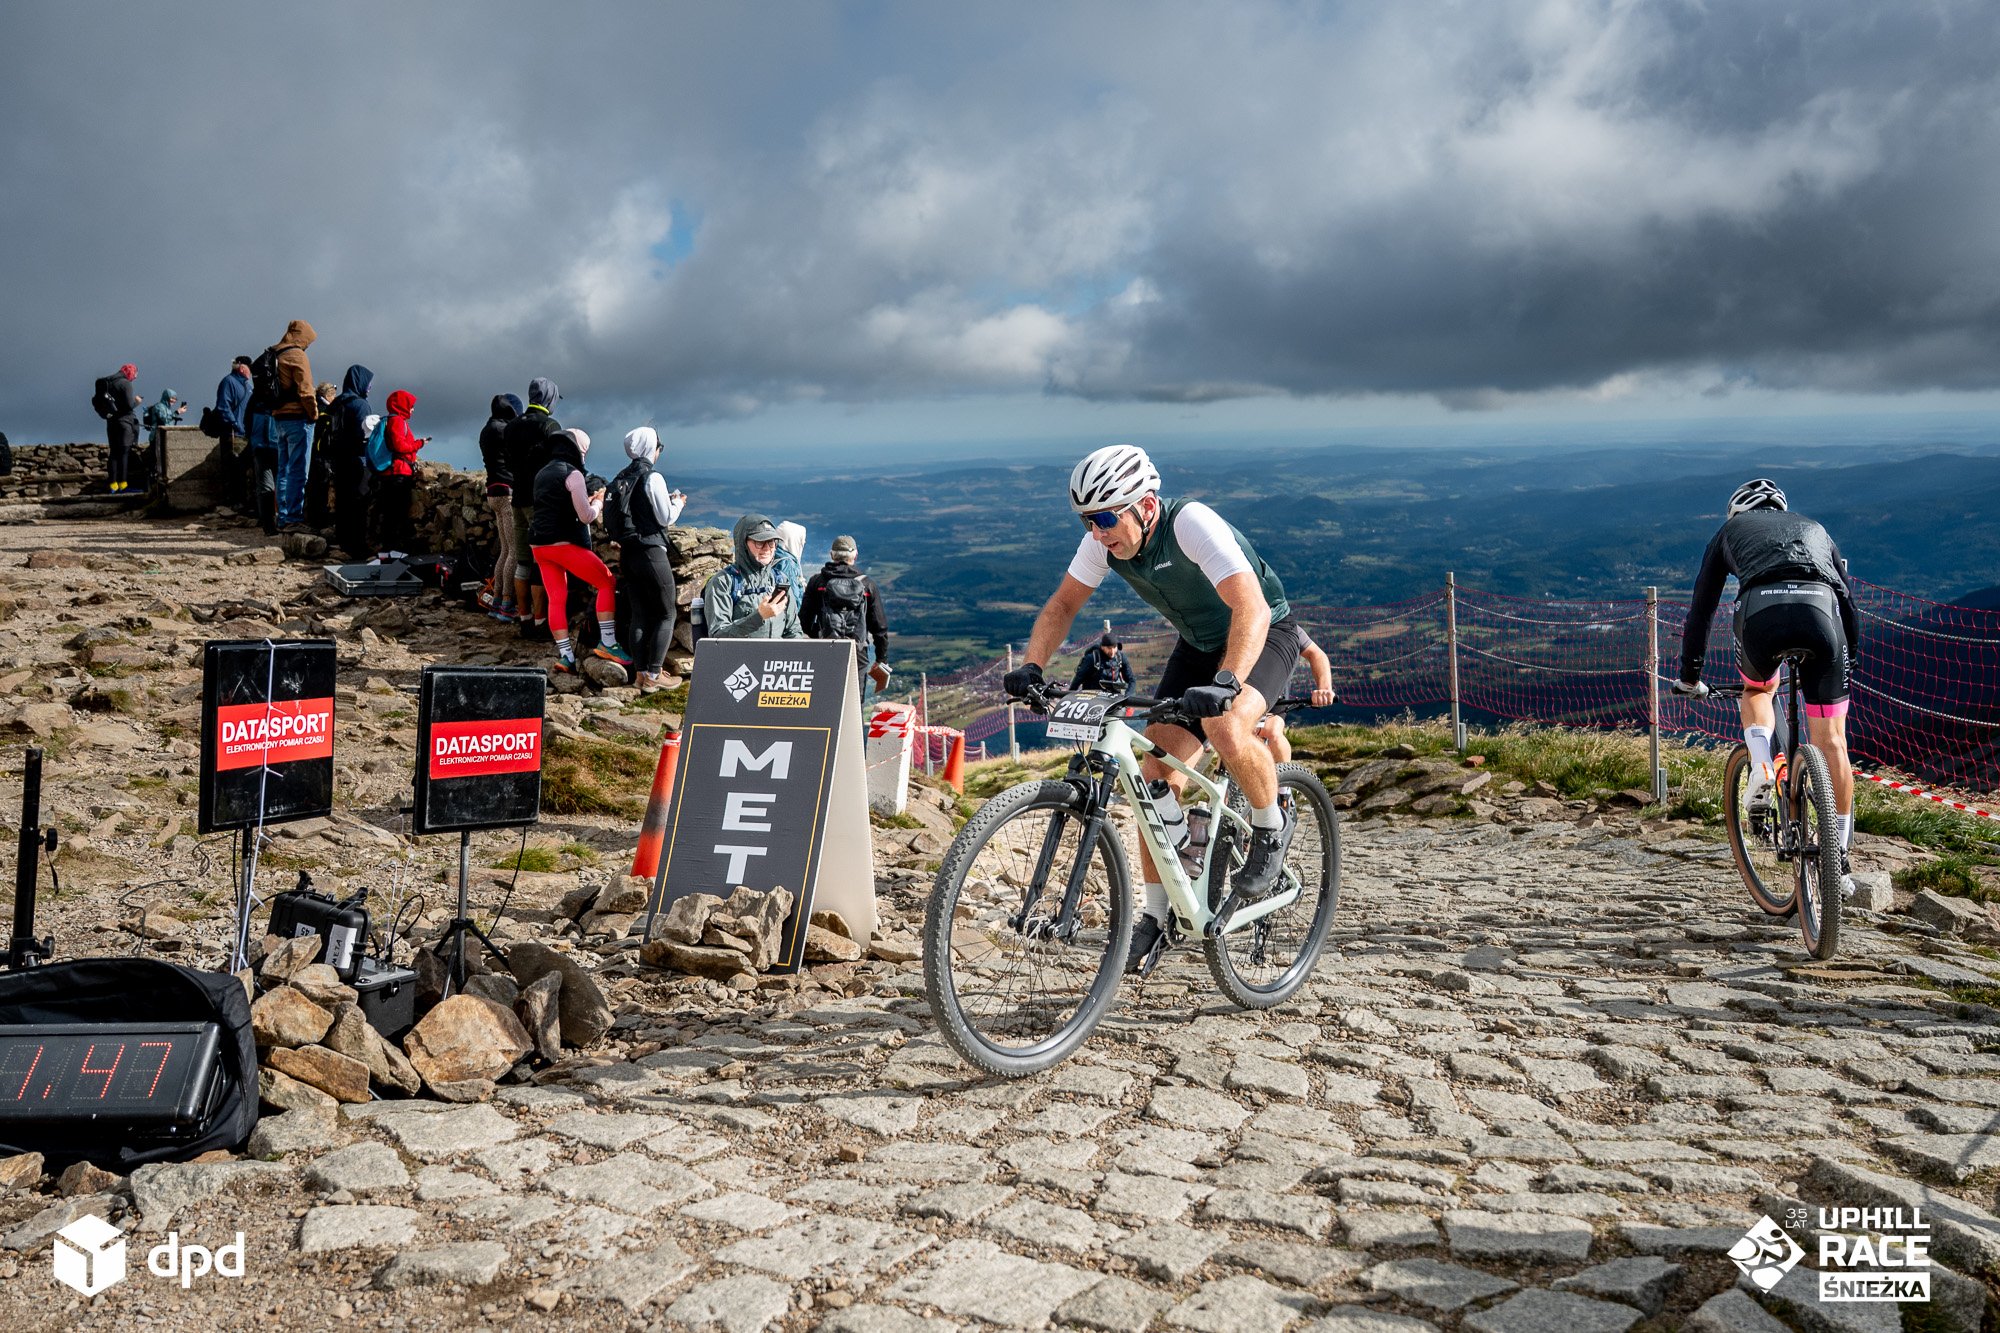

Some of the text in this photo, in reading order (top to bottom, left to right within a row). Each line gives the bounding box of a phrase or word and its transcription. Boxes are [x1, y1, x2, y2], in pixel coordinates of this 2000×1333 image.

[763, 660, 815, 673] UPHILL
[760, 674, 815, 691] RACE
[760, 693, 807, 706] ŚNIEŻKA
[1054, 700, 1089, 720] 219
[222, 712, 330, 743] DATASPORT
[226, 735, 325, 754] ELEKTRONICZNY POMIAR CZASU
[436, 732, 538, 756] DATASPORT
[440, 752, 533, 766] ELEKTRONICZNY POMIAR CZASU
[713, 739, 793, 884] MET
[1126, 773, 1188, 888] SCOTT
